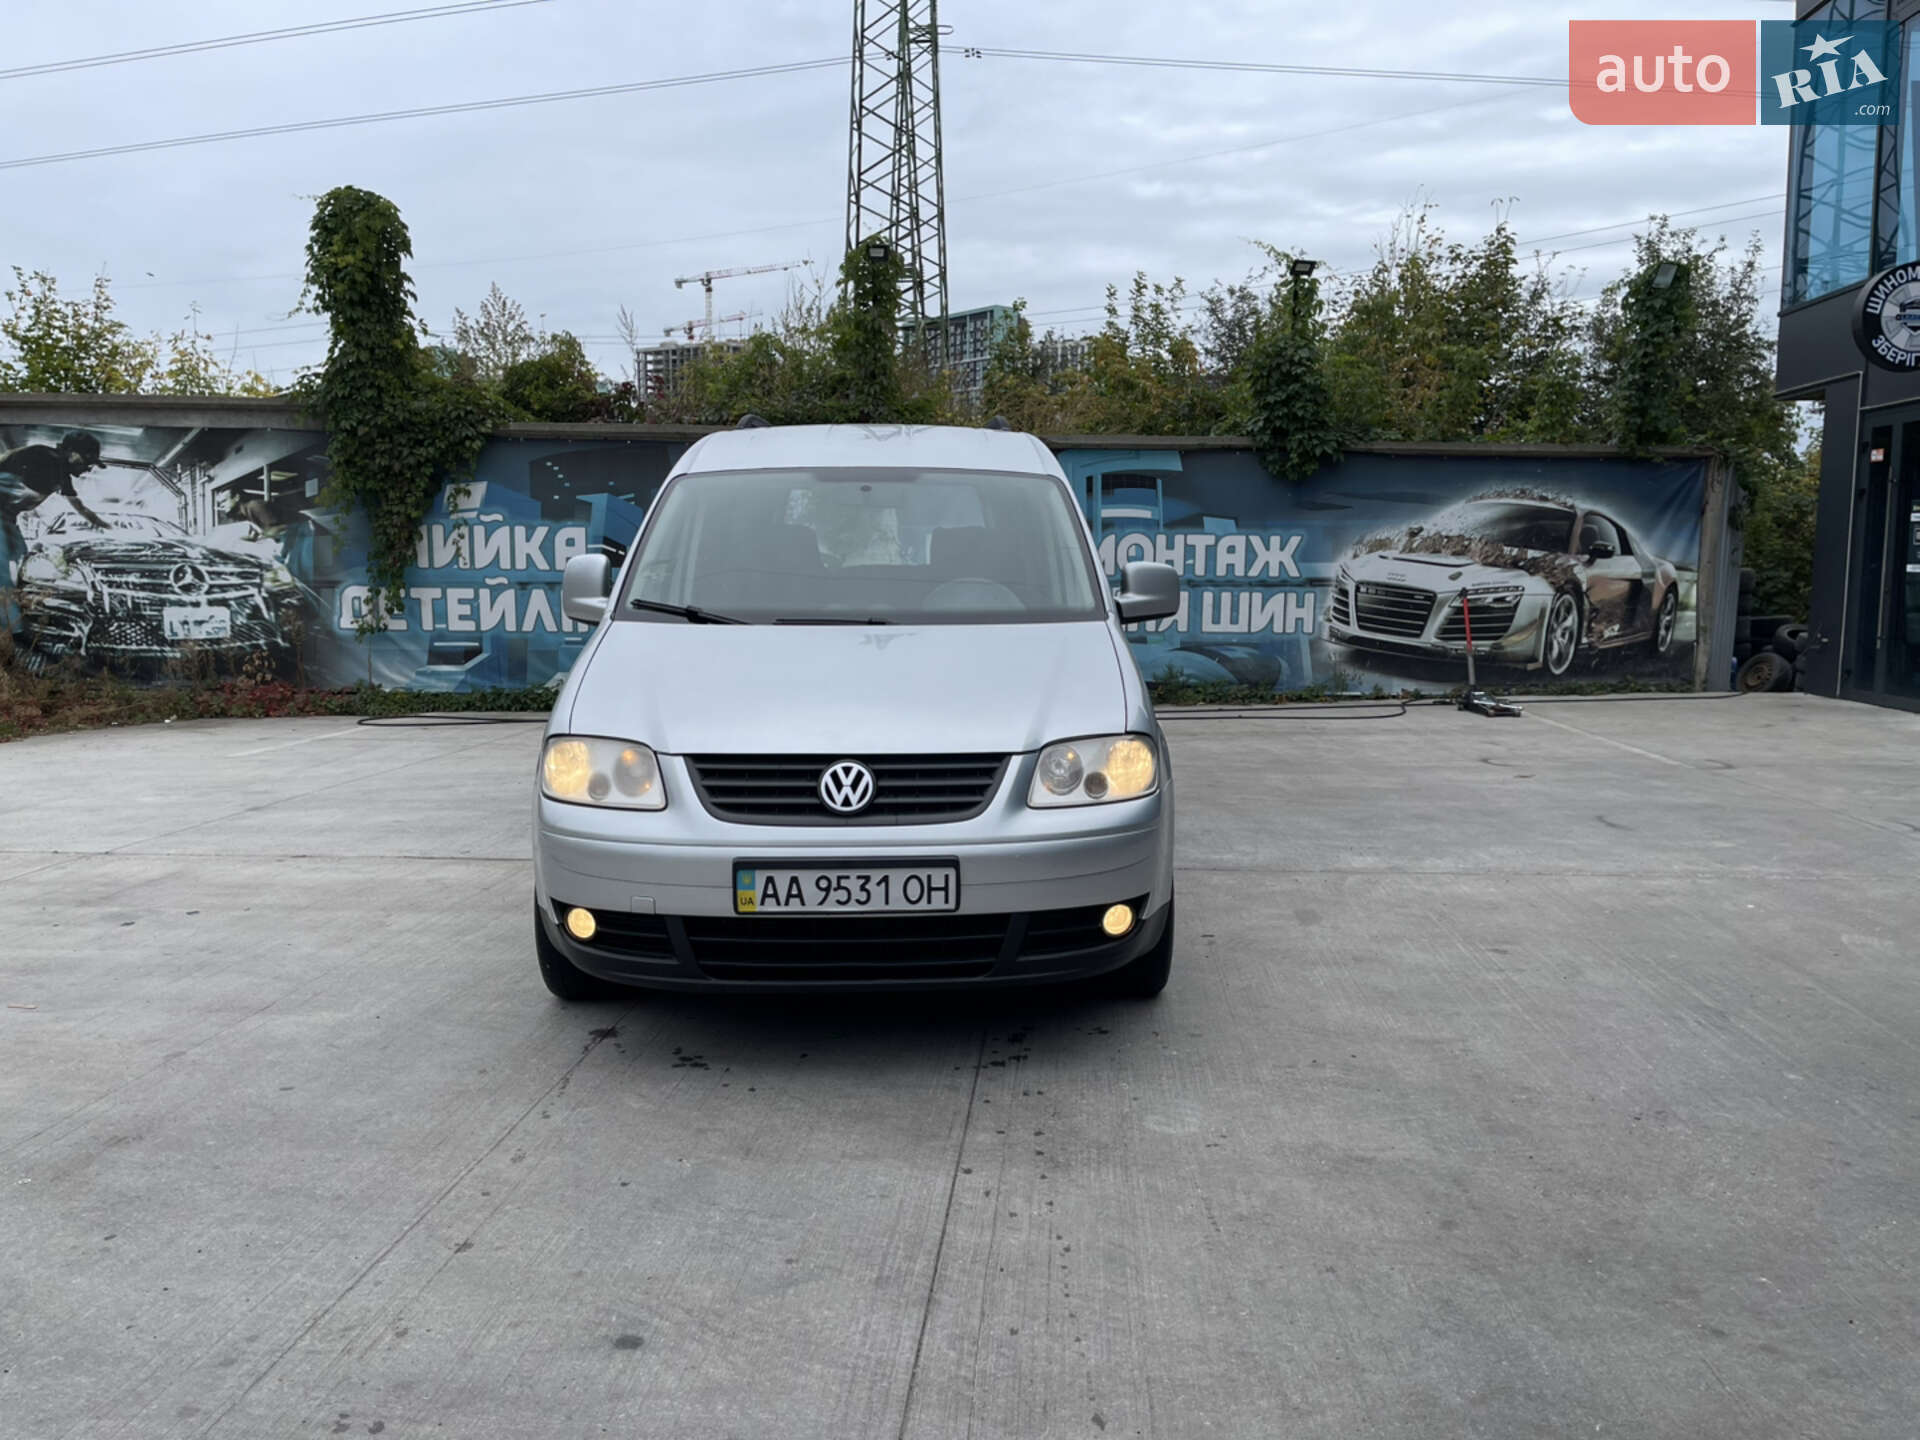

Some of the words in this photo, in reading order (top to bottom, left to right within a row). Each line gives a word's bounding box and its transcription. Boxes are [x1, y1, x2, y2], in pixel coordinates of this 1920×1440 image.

[1202, 590, 1316, 634] ШИН
[740, 896, 754, 905] UA
[759, 875, 806, 906] AA
[815, 874, 890, 905] 9531
[902, 873, 950, 905] OH
